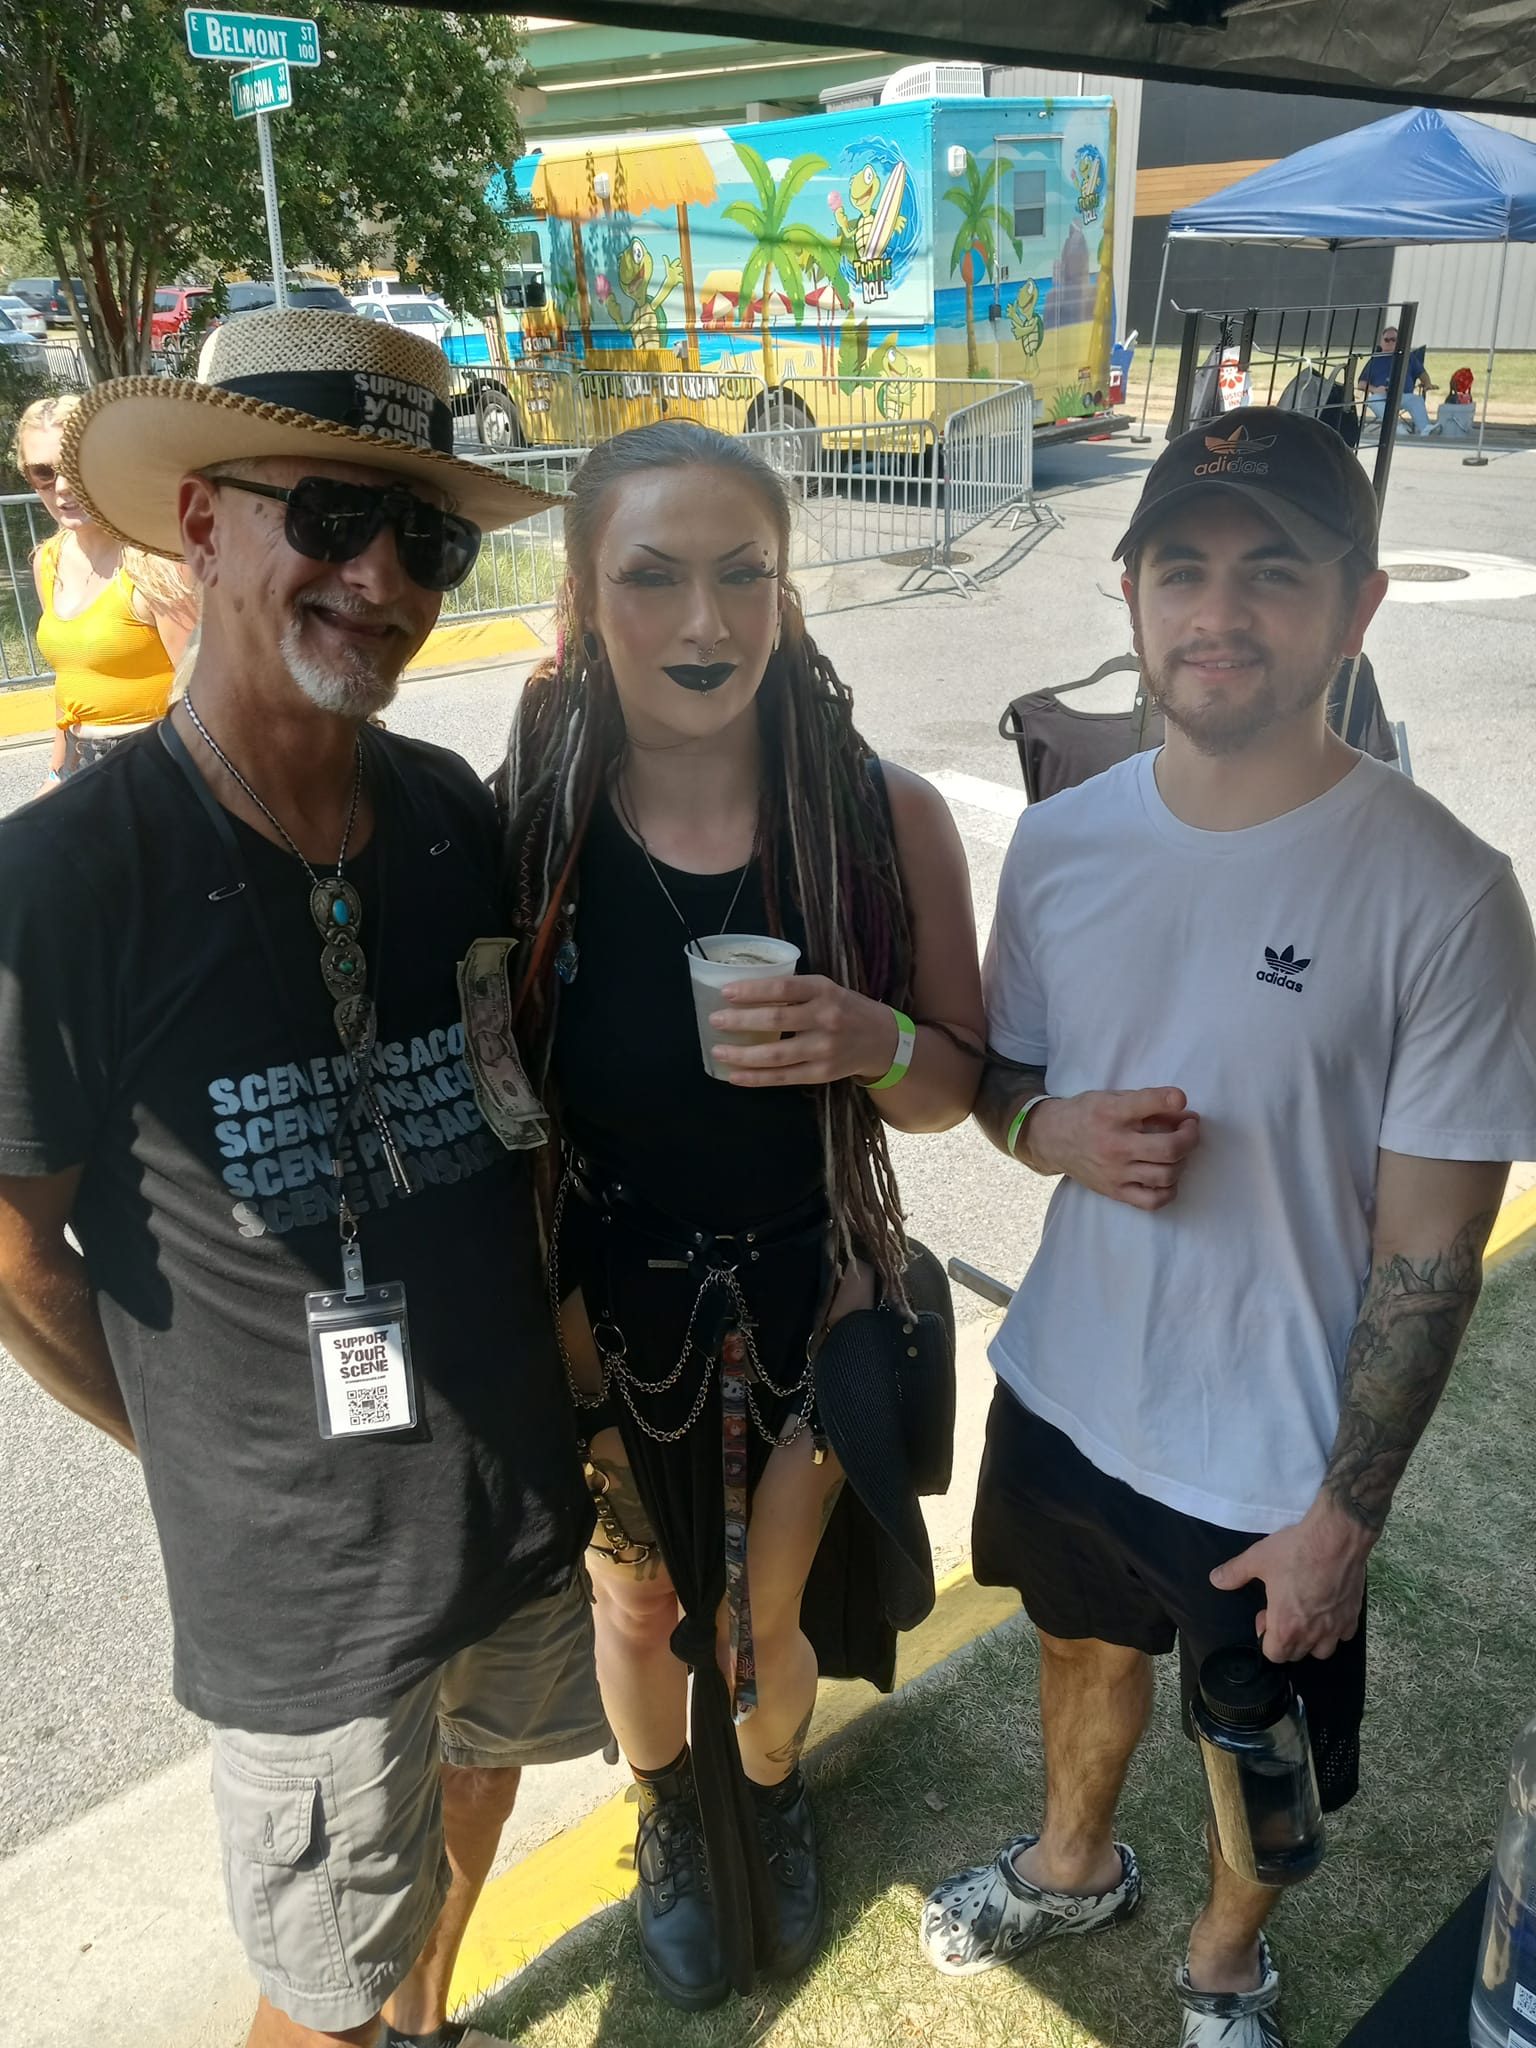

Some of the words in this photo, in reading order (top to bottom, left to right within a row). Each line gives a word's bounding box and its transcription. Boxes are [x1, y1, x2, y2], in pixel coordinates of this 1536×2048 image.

[190, 15, 199, 32] E
[205, 16, 288, 57] BELMONT
[300, 26, 313, 41] ST
[298, 43, 315, 59] 100
[278, 65, 286, 82] ST
[852, 257, 892, 284] TURTLE
[862, 279, 889, 304] ROLL
[364, 395, 431, 440] YOUR
[1194, 456, 1269, 475] adidas
[1256, 970, 1304, 992] adidas
[208, 1056, 334, 1116] SCENE
[214, 1097, 339, 1158] SCENE
[333, 1329, 389, 1350] SUPPORT
[340, 1344, 386, 1365] YOUR
[339, 1359, 389, 1379] SCENE
